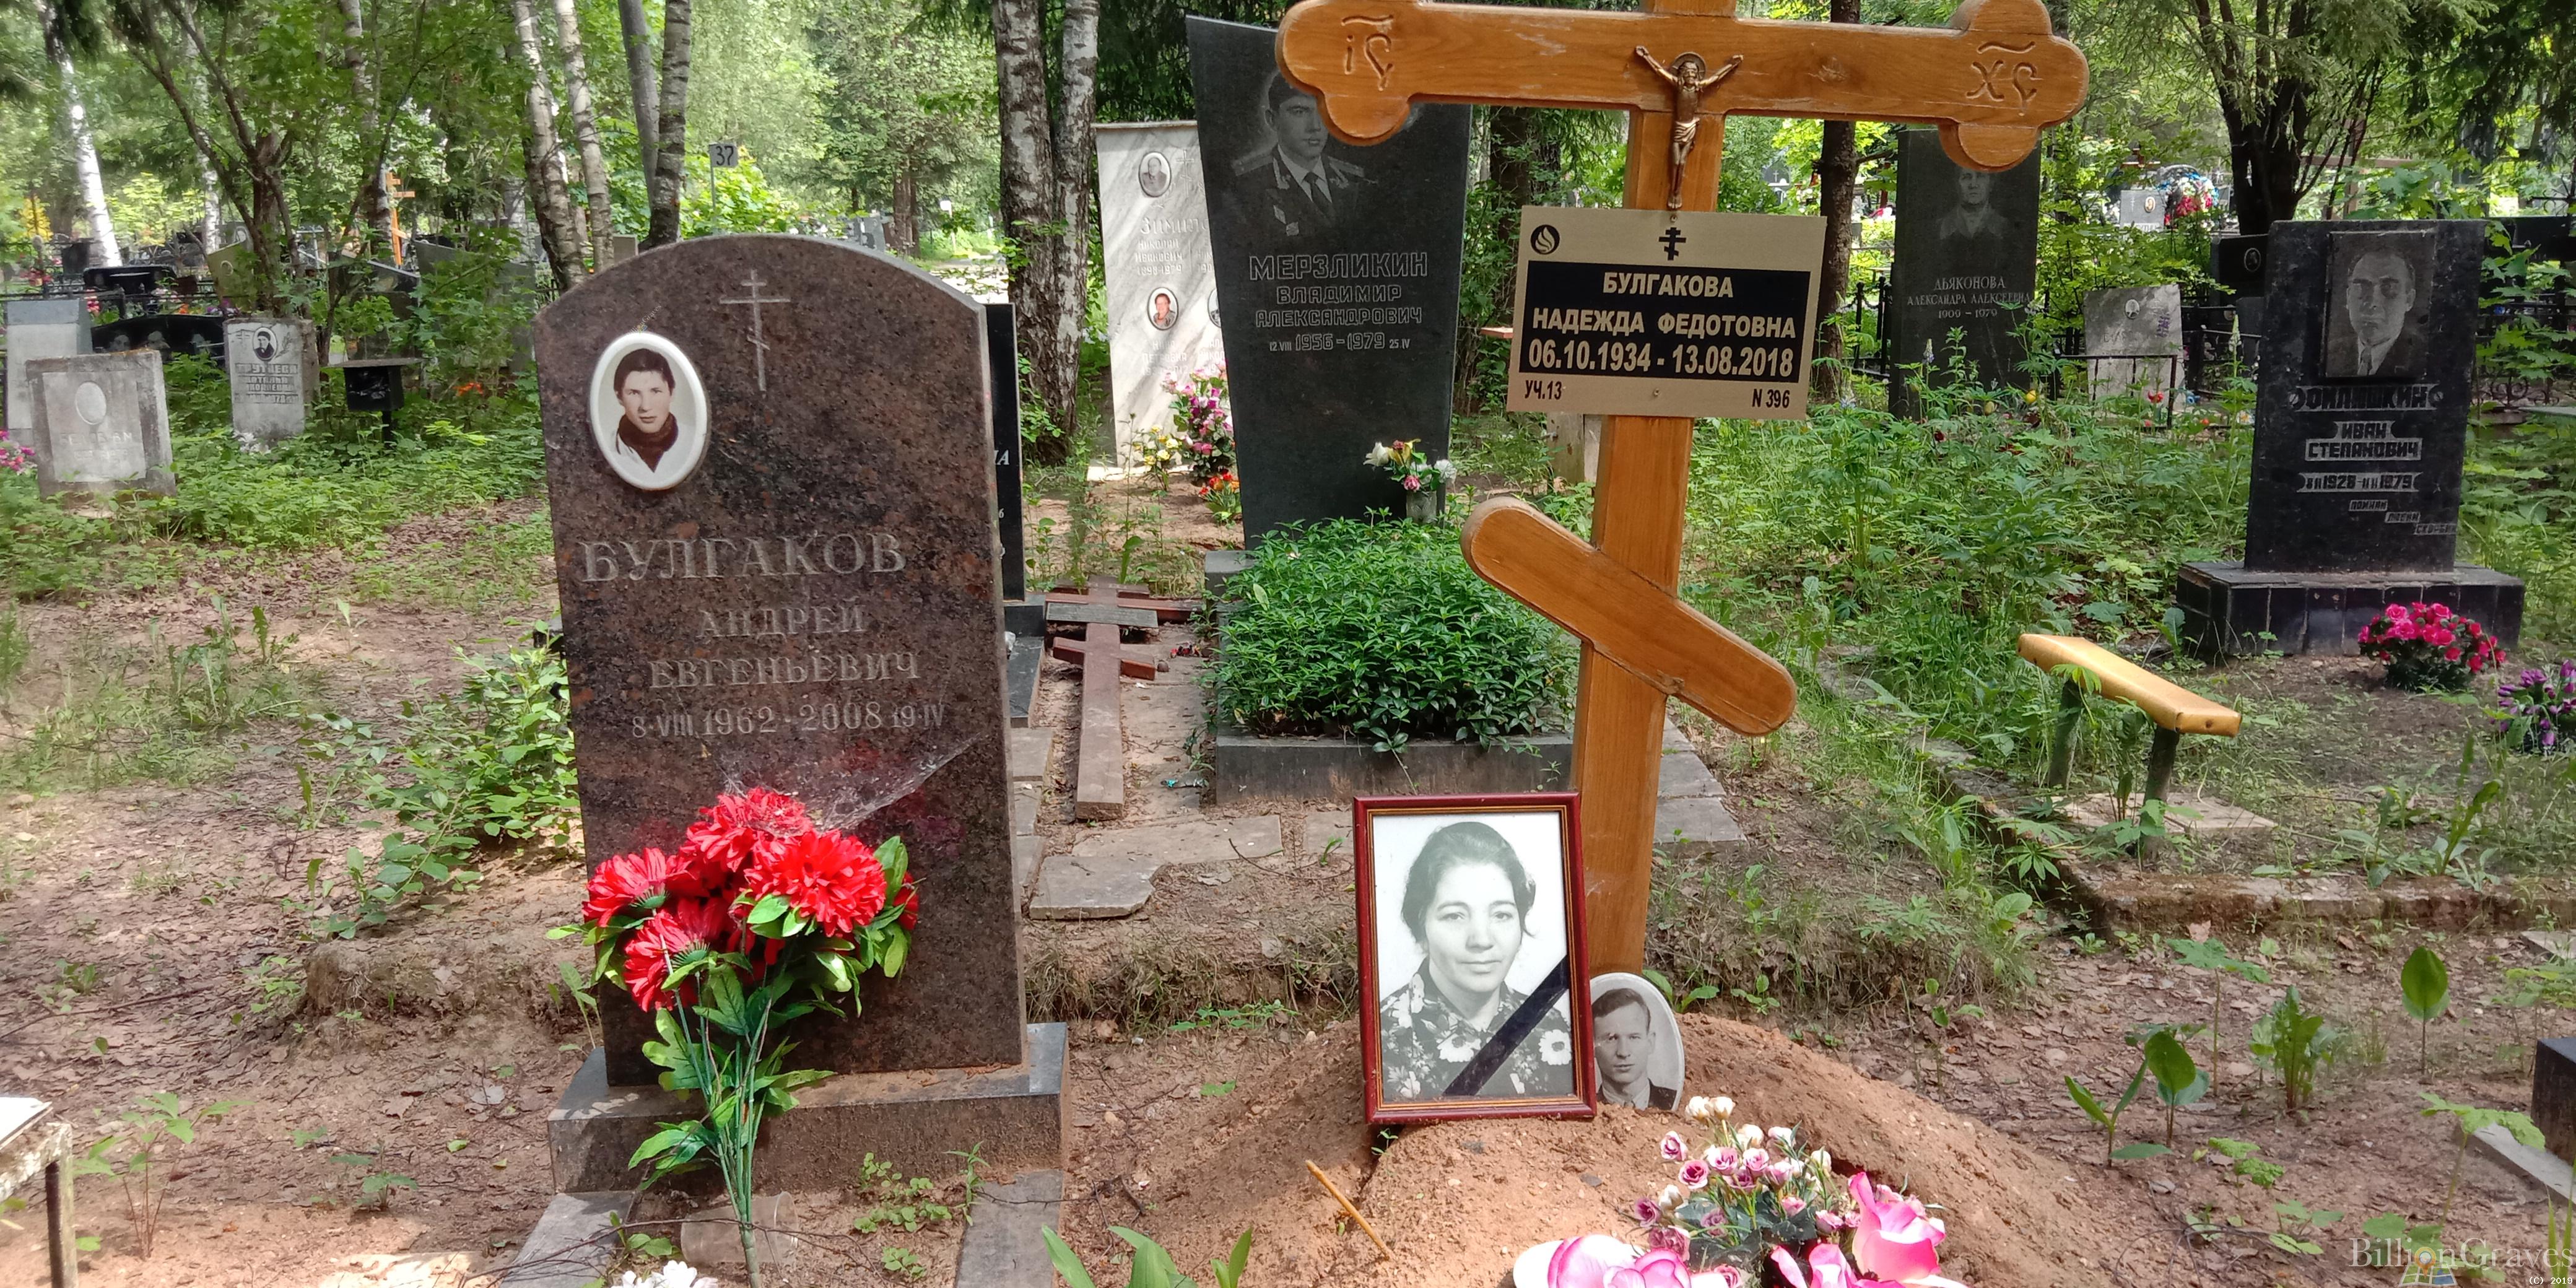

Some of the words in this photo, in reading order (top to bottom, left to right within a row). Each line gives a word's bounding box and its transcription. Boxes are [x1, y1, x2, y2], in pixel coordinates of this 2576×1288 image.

[716, 146, 734, 166] 37
[1249, 252, 1427, 281] МЕРЗЛИКИН
[1276, 285, 1402, 304] ВЛАДИМИР
[1603, 271, 1734, 298] БУЛГАКОВА
[1933, 276, 2006, 290] ДЬЯКОНОВА
[1907, 294, 1967, 306] АЛЕКСАНДРА
[1255, 307, 1422, 328] АЛЕКСАНДРОВИЧ
[1532, 307, 1645, 336] НАДЕЖДА
[1658, 312, 1796, 339] ФЕДОТОВНА
[1528, 338, 1651, 372] 06.10.1934
[1672, 344, 1794, 377] 13.08.2018
[1525, 380, 1562, 400] УЧ.13
[1766, 389, 1790, 409] 396
[2341, 423, 2387, 439] ИВАН
[2308, 442, 2418, 458] СТЕПАНОВИЧ
[578, 533, 907, 583] БУЛГАКОВ
[696, 596, 866, 644] АНДРЕЙ
[648, 652, 922, 689] ЕВГЕНЬЕВИЧ
[702, 707, 777, 736] 1962
[799, 702, 882, 731] 2008
